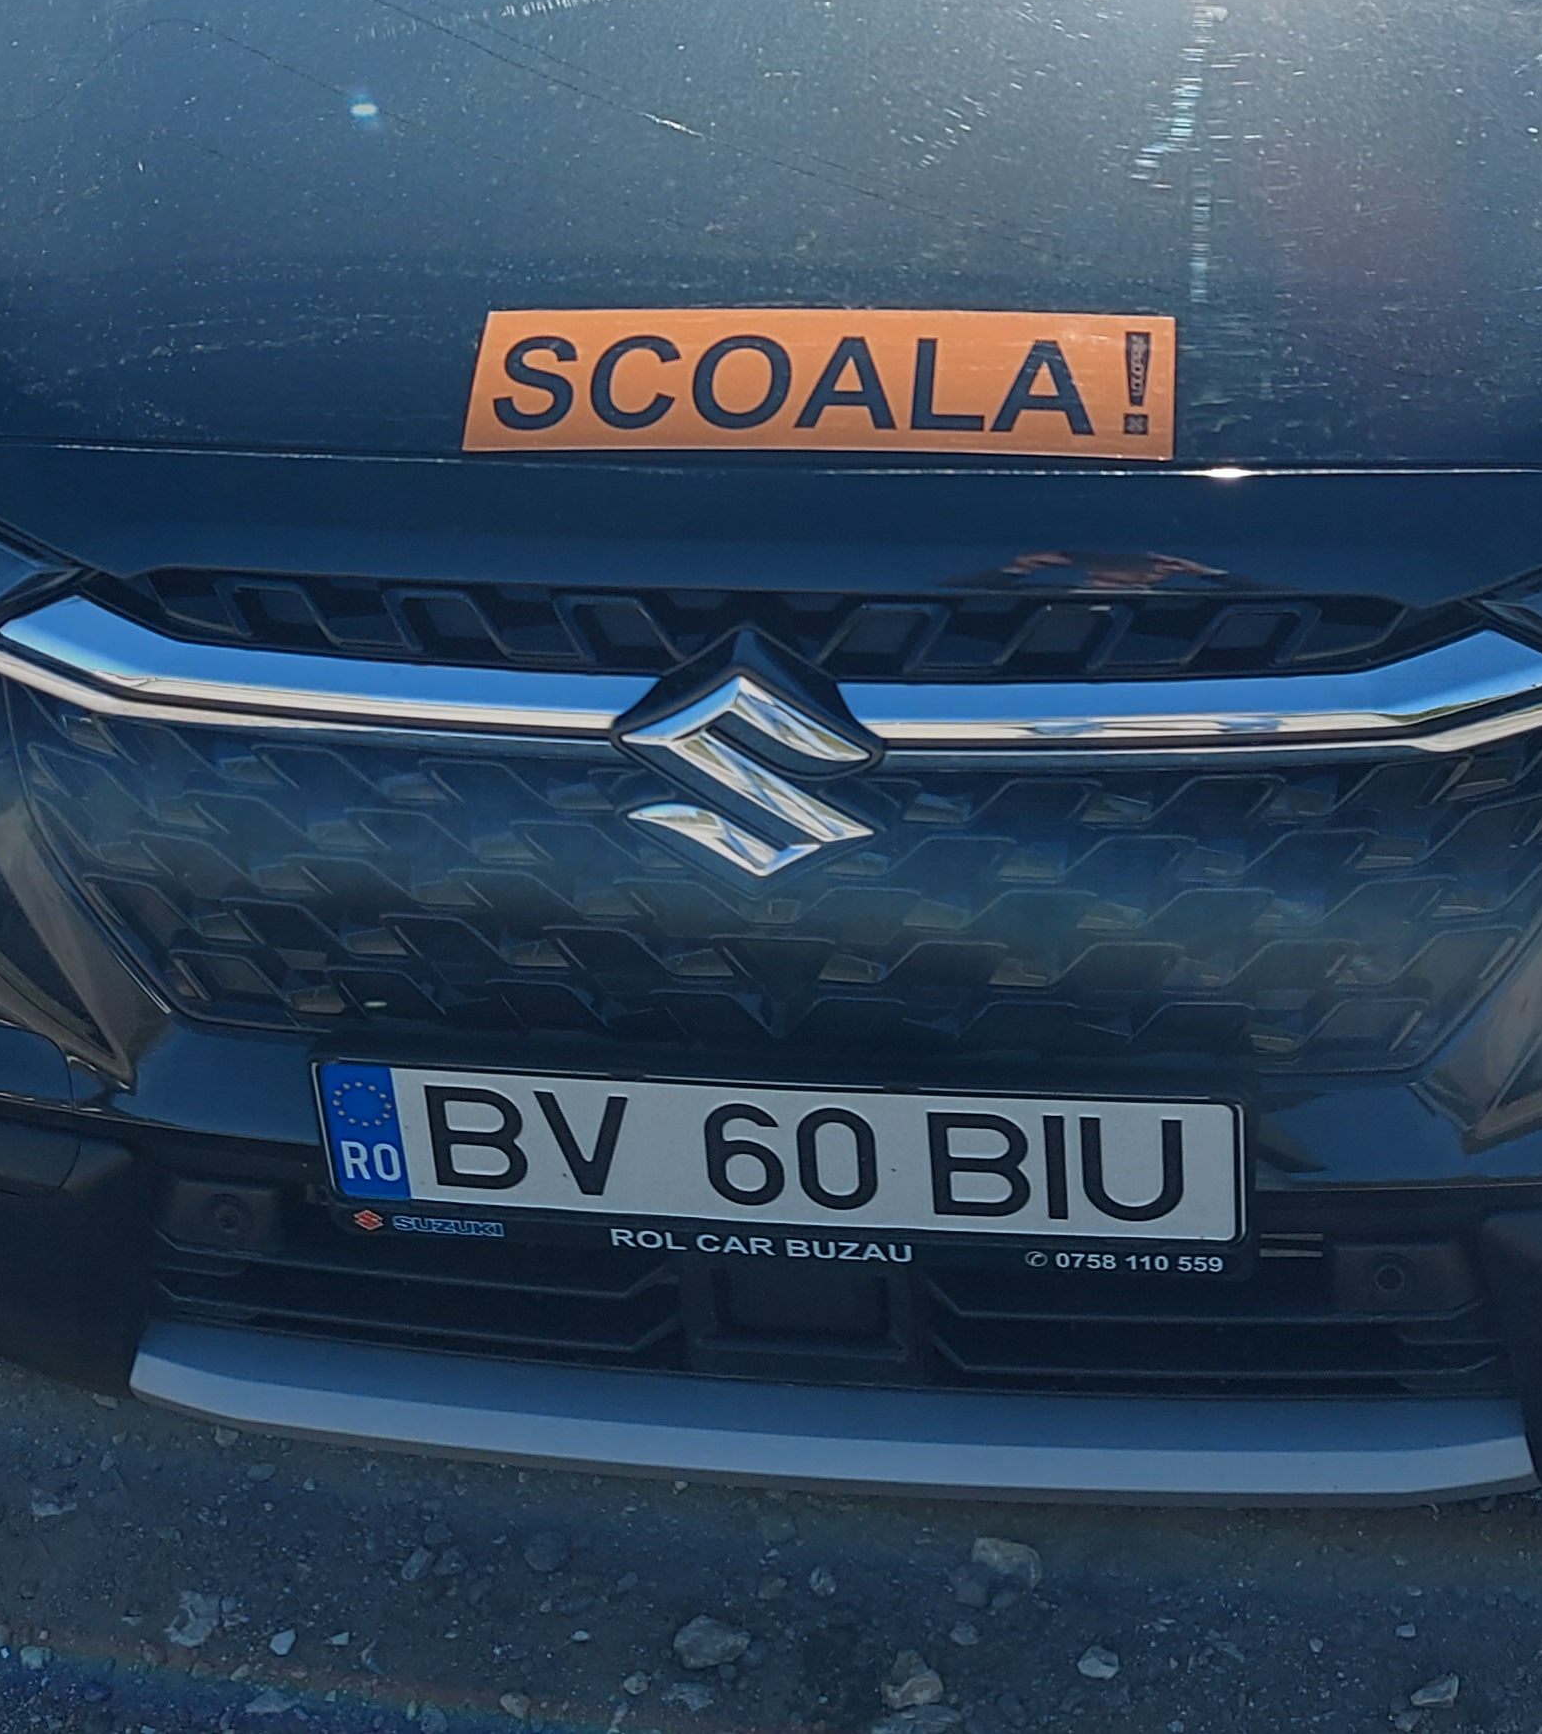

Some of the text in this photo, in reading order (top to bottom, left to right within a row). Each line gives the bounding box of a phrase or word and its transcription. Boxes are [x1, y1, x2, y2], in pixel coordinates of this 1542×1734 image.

[340, 1084, 1184, 1223] RO BV 60 BIU
[392, 1215, 506, 1238] SUZUKI
[610, 1227, 913, 1264] ROL CAR BUZAU
[1054, 1252, 1224, 1273] 0758 110 559
